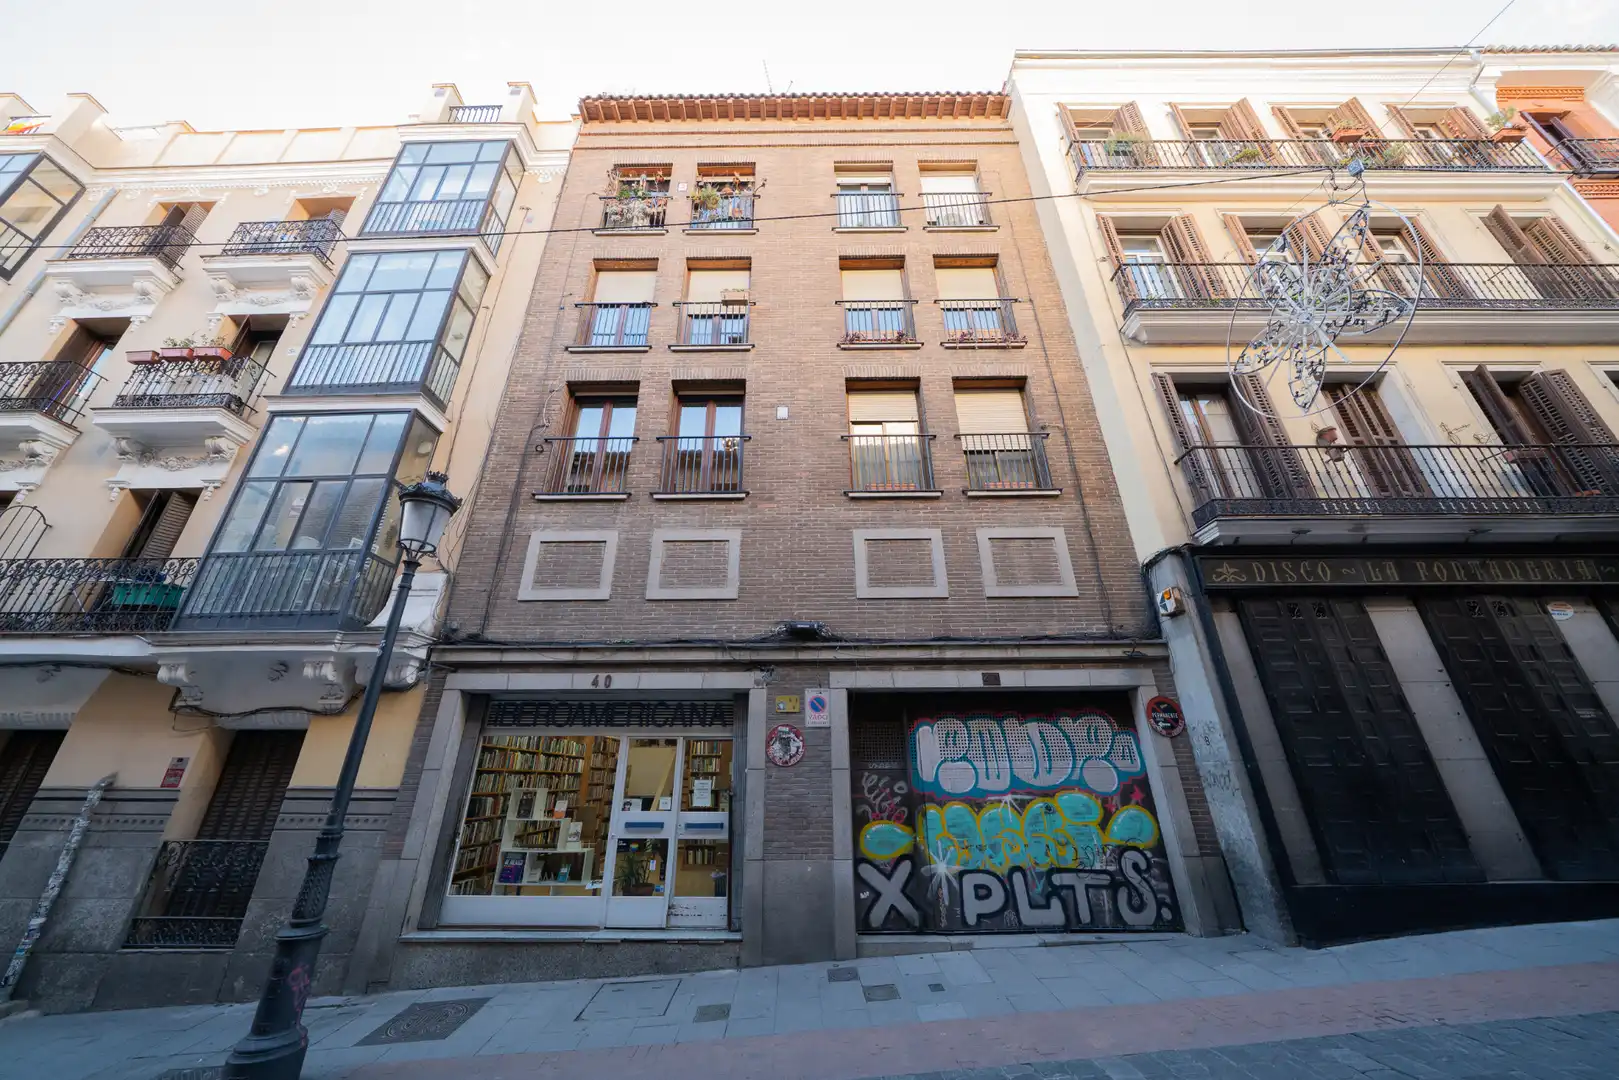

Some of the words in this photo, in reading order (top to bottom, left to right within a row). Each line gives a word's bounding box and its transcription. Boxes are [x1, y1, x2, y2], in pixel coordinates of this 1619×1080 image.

[1252, 560, 1331, 582] DISCO
[1366, 560, 1399, 582] LA
[591, 674, 613, 689] 40
[489, 701, 728, 728] IBEROAMERICANA
[855, 856, 922, 928] X
